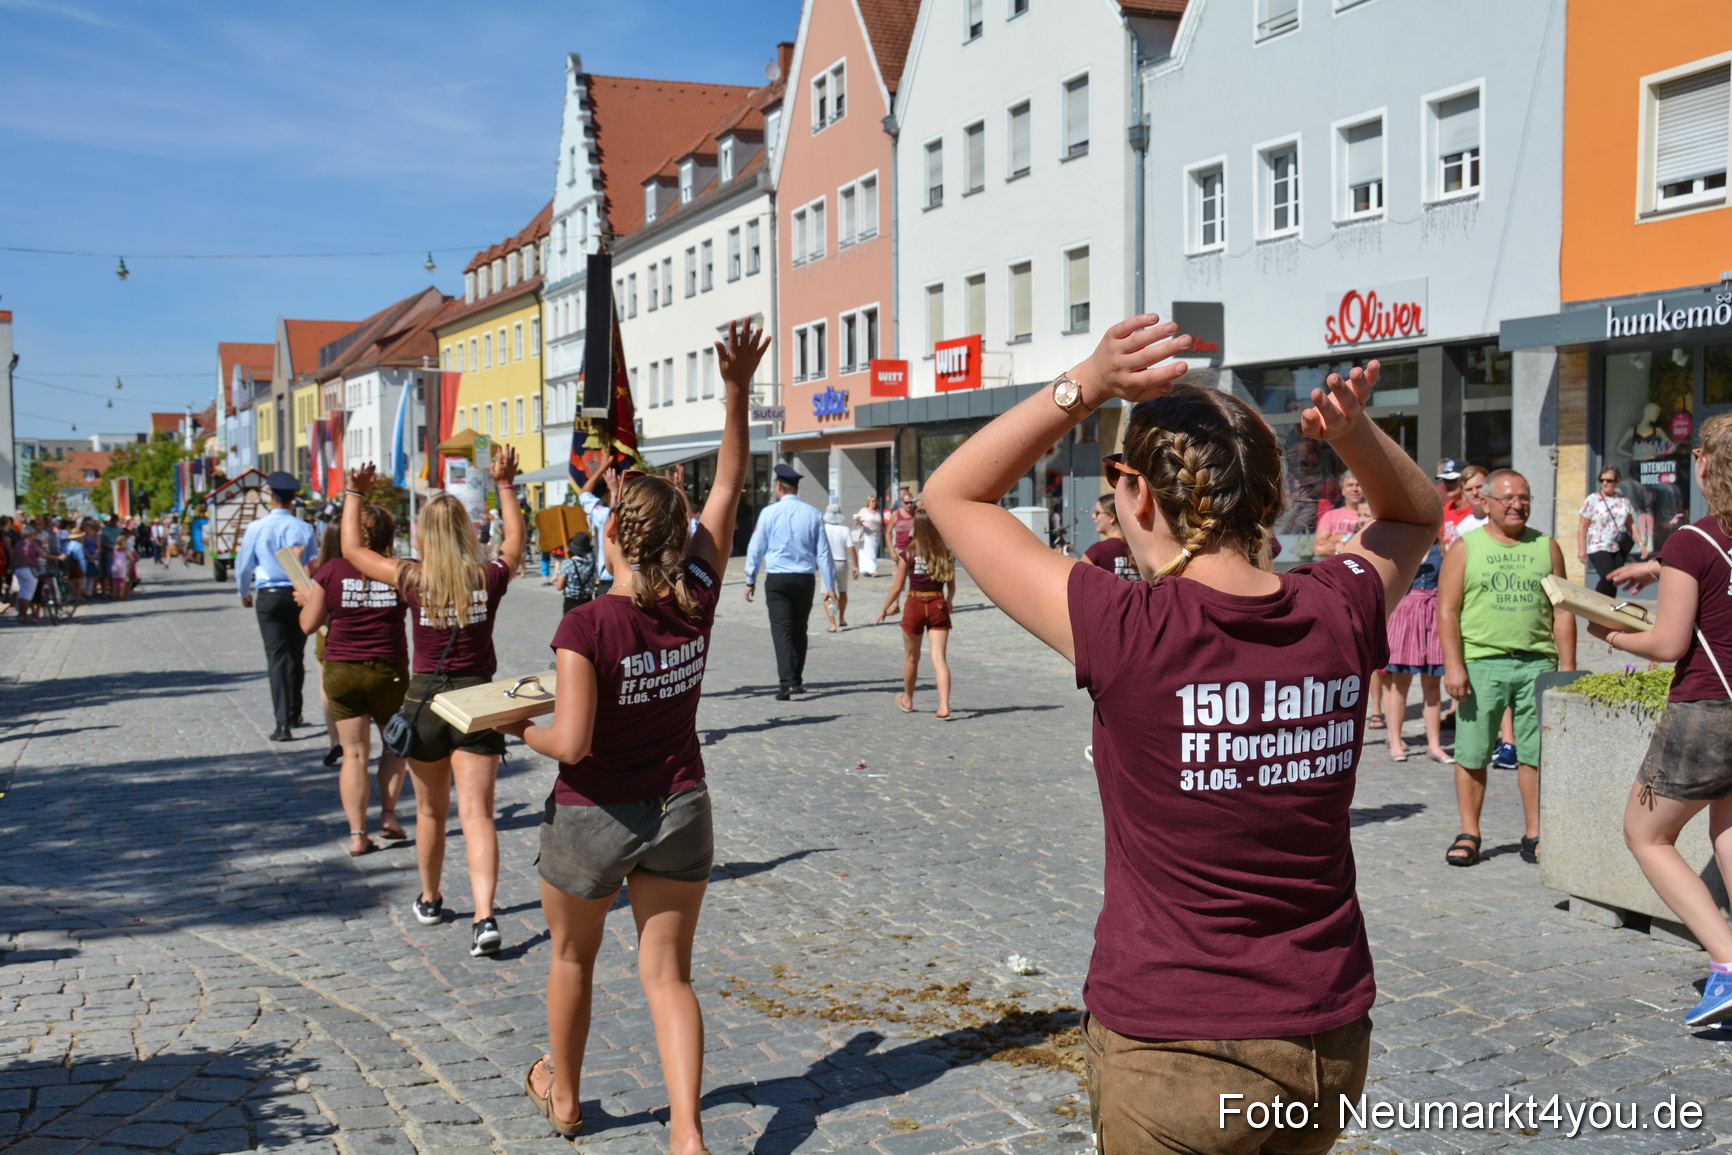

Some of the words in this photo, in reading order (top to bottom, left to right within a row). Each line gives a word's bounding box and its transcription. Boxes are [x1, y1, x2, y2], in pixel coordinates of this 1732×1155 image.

[1325, 290, 1424, 344] s.Oliver
[935, 345, 968, 375] WITT
[878, 371, 904, 382] WITT
[753, 408, 784, 419] sutor
[1640, 461, 1676, 473] INTENSITY
[1640, 473, 1660, 485] MODE
[1486, 554, 1535, 564] QUALITY
[341, 578, 363, 591] 150
[688, 563, 714, 588] Sophie
[1496, 594, 1533, 603] BRAND
[620, 651, 656, 678] 150
[660, 635, 705, 670] Jahre
[621, 680, 637, 695] FF
[639, 656, 704, 691] Forchheim
[618, 692, 651, 705] 31.05.
[1175, 681, 1250, 726] 150
[1261, 675, 1360, 722] Jahre
[1181, 732, 1211, 763] FF
[1217, 719, 1354, 763] Forchheim
[1180, 768, 1242, 791] 31.05.
[1258, 748, 1353, 787] 02.06.2019
